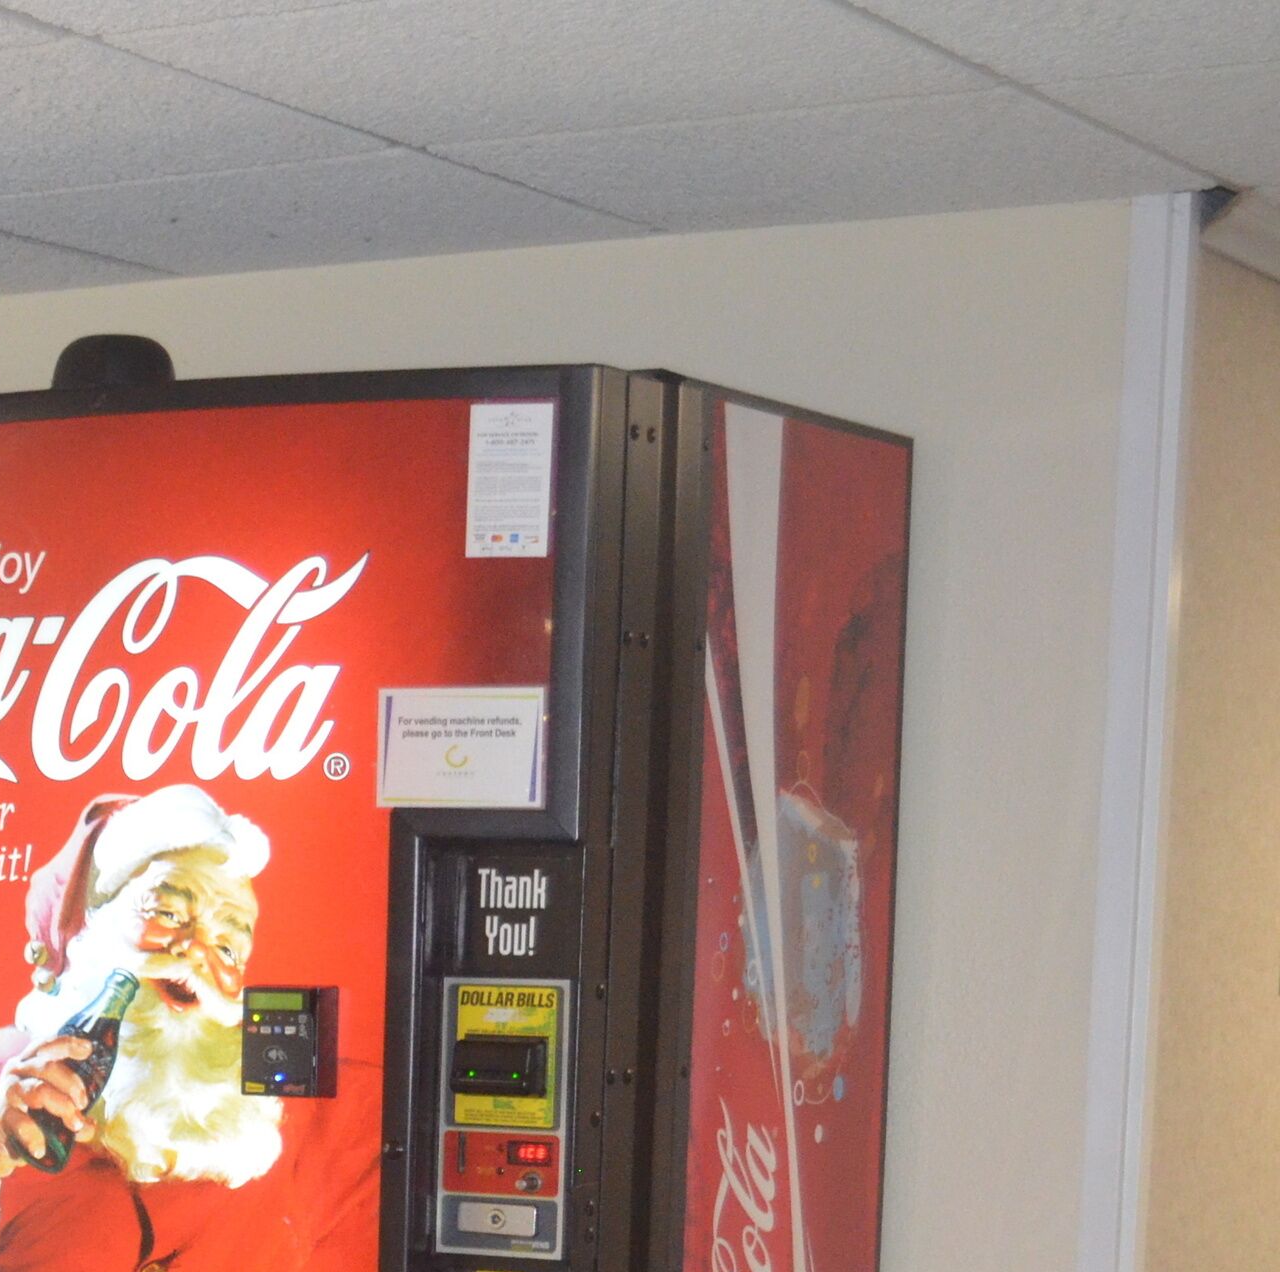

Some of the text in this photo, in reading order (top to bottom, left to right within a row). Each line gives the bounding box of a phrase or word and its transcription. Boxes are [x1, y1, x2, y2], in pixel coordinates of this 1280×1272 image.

[398, 717, 413, 725] For
[414, 716, 448, 727] vending
[449, 716, 485, 725] machine
[402, 729, 516, 740] please go to the Front Desk
[478, 868, 547, 910] Thank
[485, 915, 536, 957] You!
[461, 990, 555, 1009] DOLLAR BILLS
